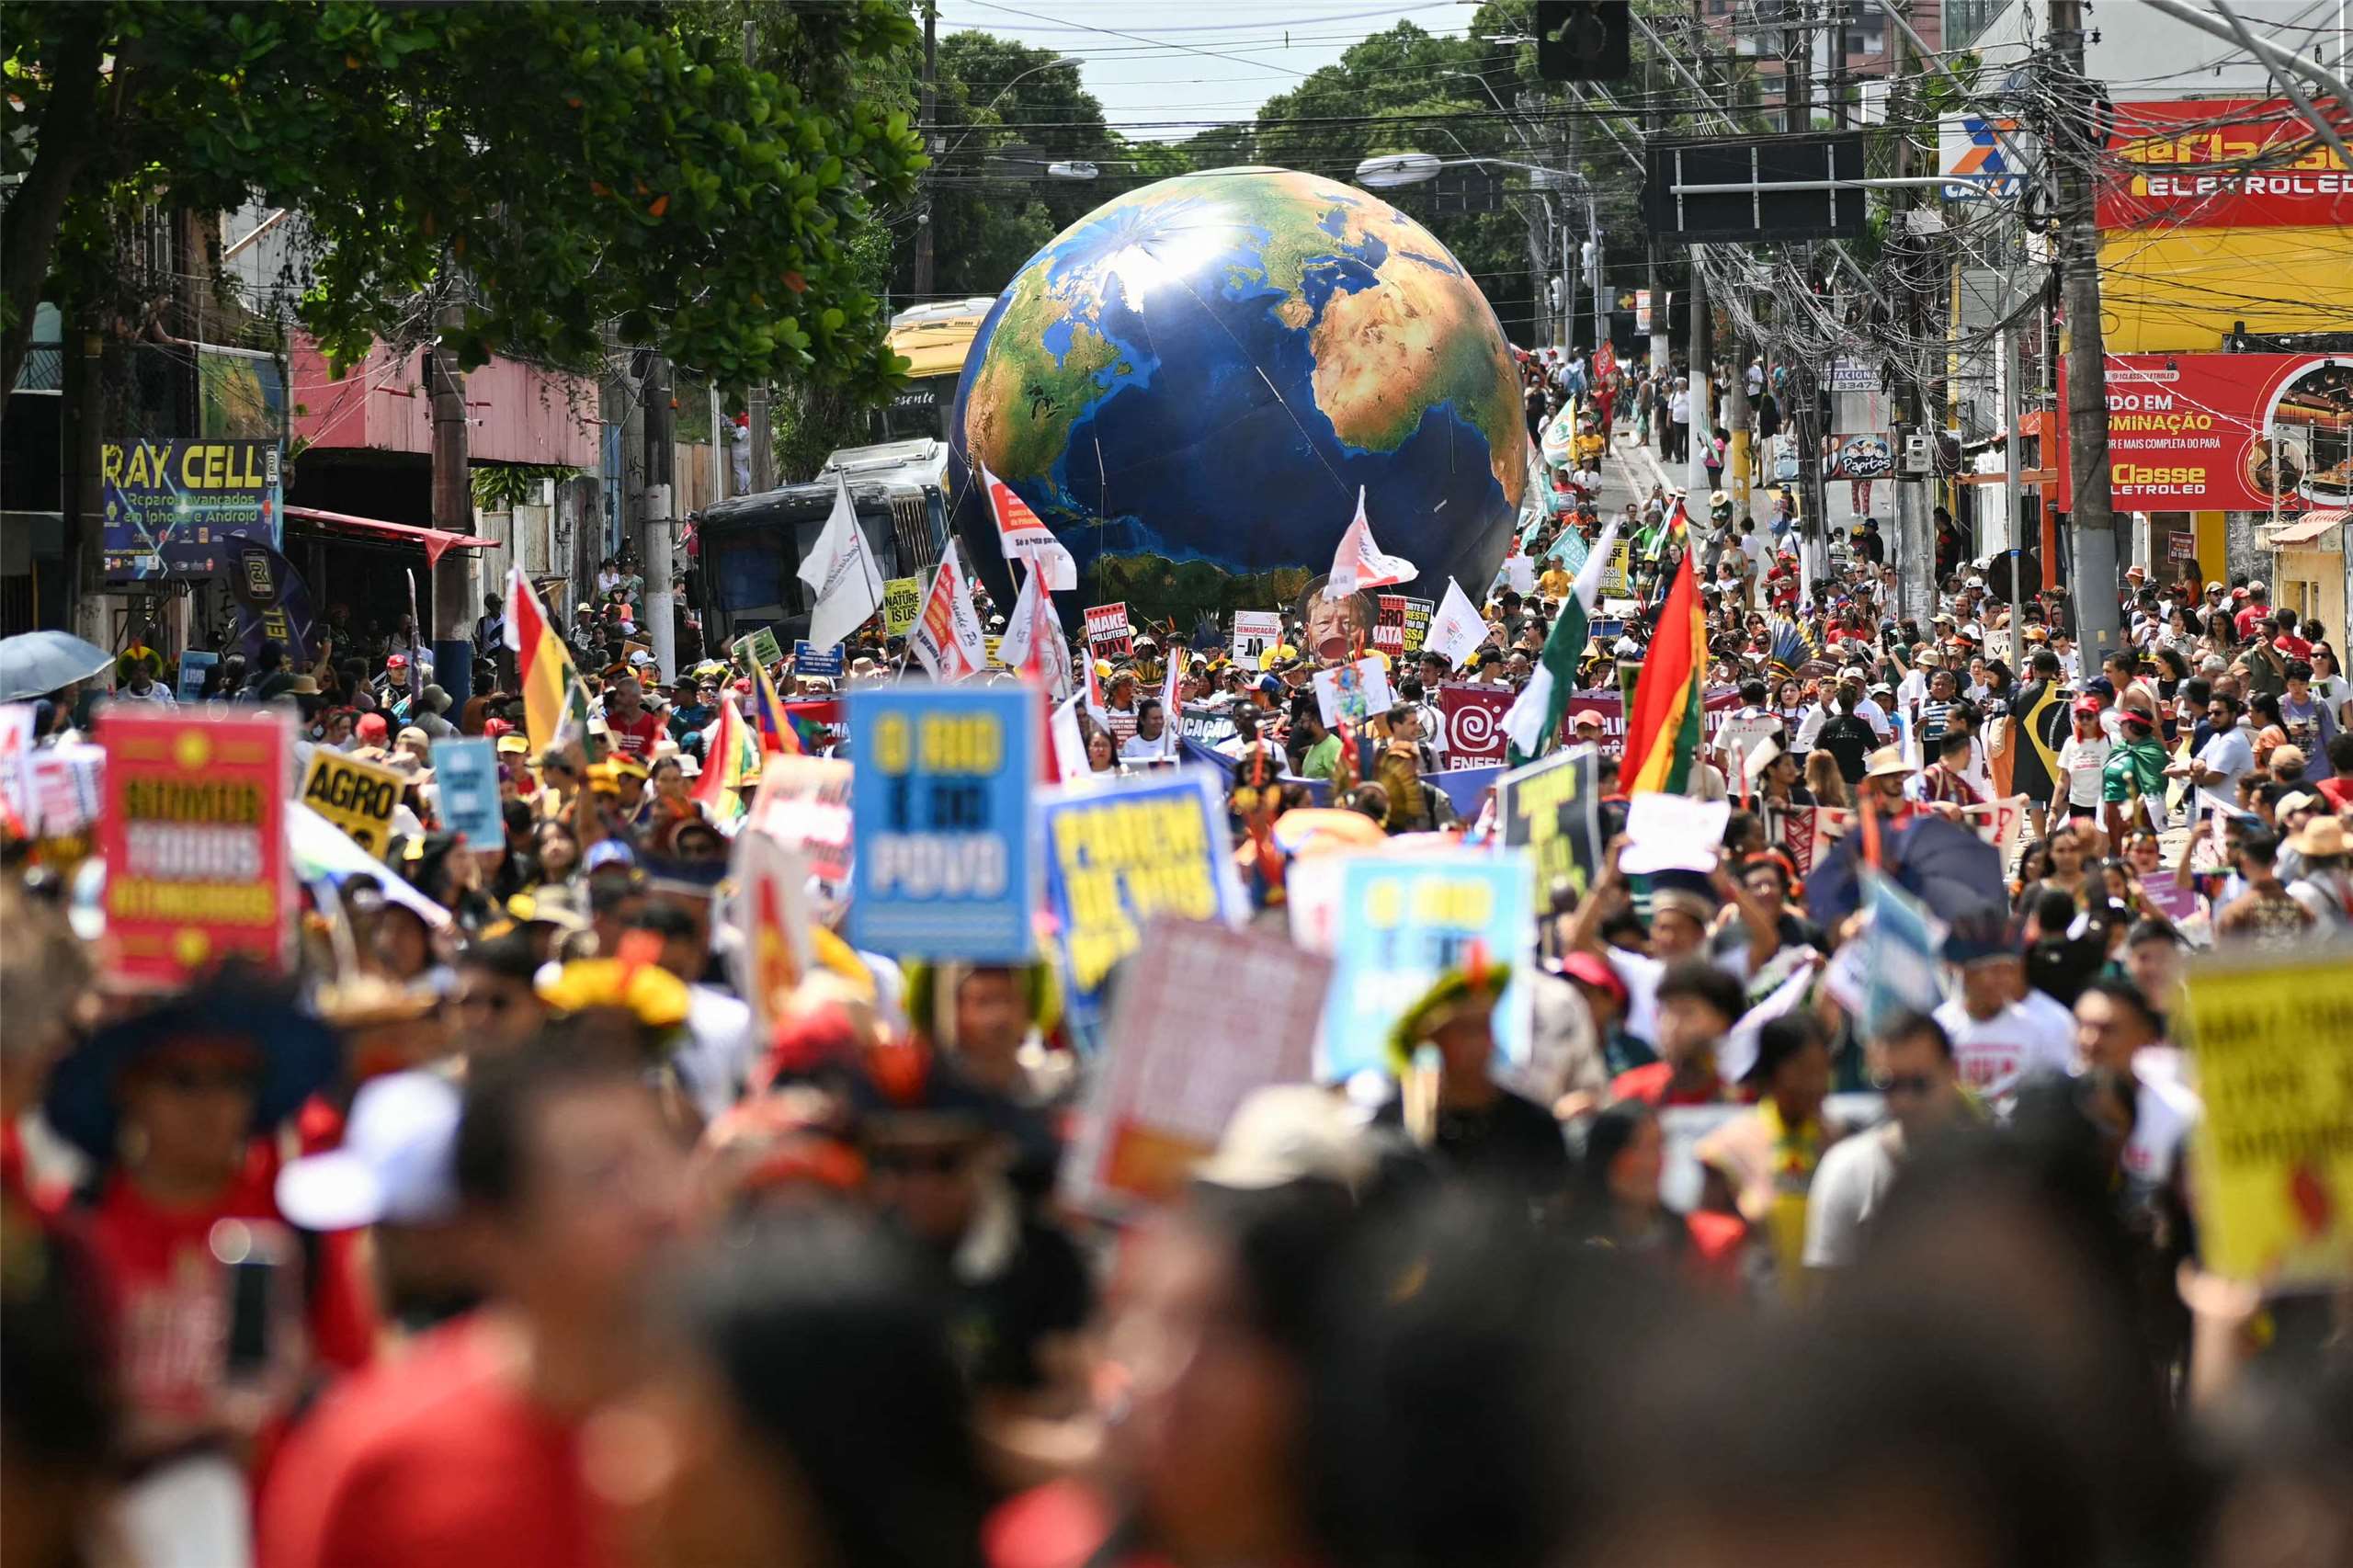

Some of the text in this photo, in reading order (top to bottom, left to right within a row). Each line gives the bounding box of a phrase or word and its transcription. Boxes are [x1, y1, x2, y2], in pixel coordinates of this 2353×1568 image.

[2143, 394, 2173, 411] EM
[2118, 440, 2122, 449] E
[2123, 440, 2143, 449] MAIS
[2144, 439, 2186, 449] COMPLETA
[2187, 439, 2199, 449] DO
[2200, 436, 2221, 449] PARÁ
[101, 443, 174, 489] RAY
[181, 444, 264, 489] CELL
[1842, 457, 1892, 473] Papitos
[2111, 462, 2206, 485] Classe
[187, 492, 256, 510] avançados
[123, 512, 143, 523] em
[194, 512, 202, 523] e
[205, 509, 258, 525] Android
[885, 592, 920, 608] NATURE
[892, 608, 917, 623] IS US
[1087, 612, 1127, 634] MAKE
[1378, 608, 1404, 627] GRO
[1091, 627, 1129, 643] POLLUTERS
[1236, 625, 1277, 635] DEMARCAÇÃO
[1096, 637, 1127, 660] PAY
[306, 761, 396, 821] AGRO
